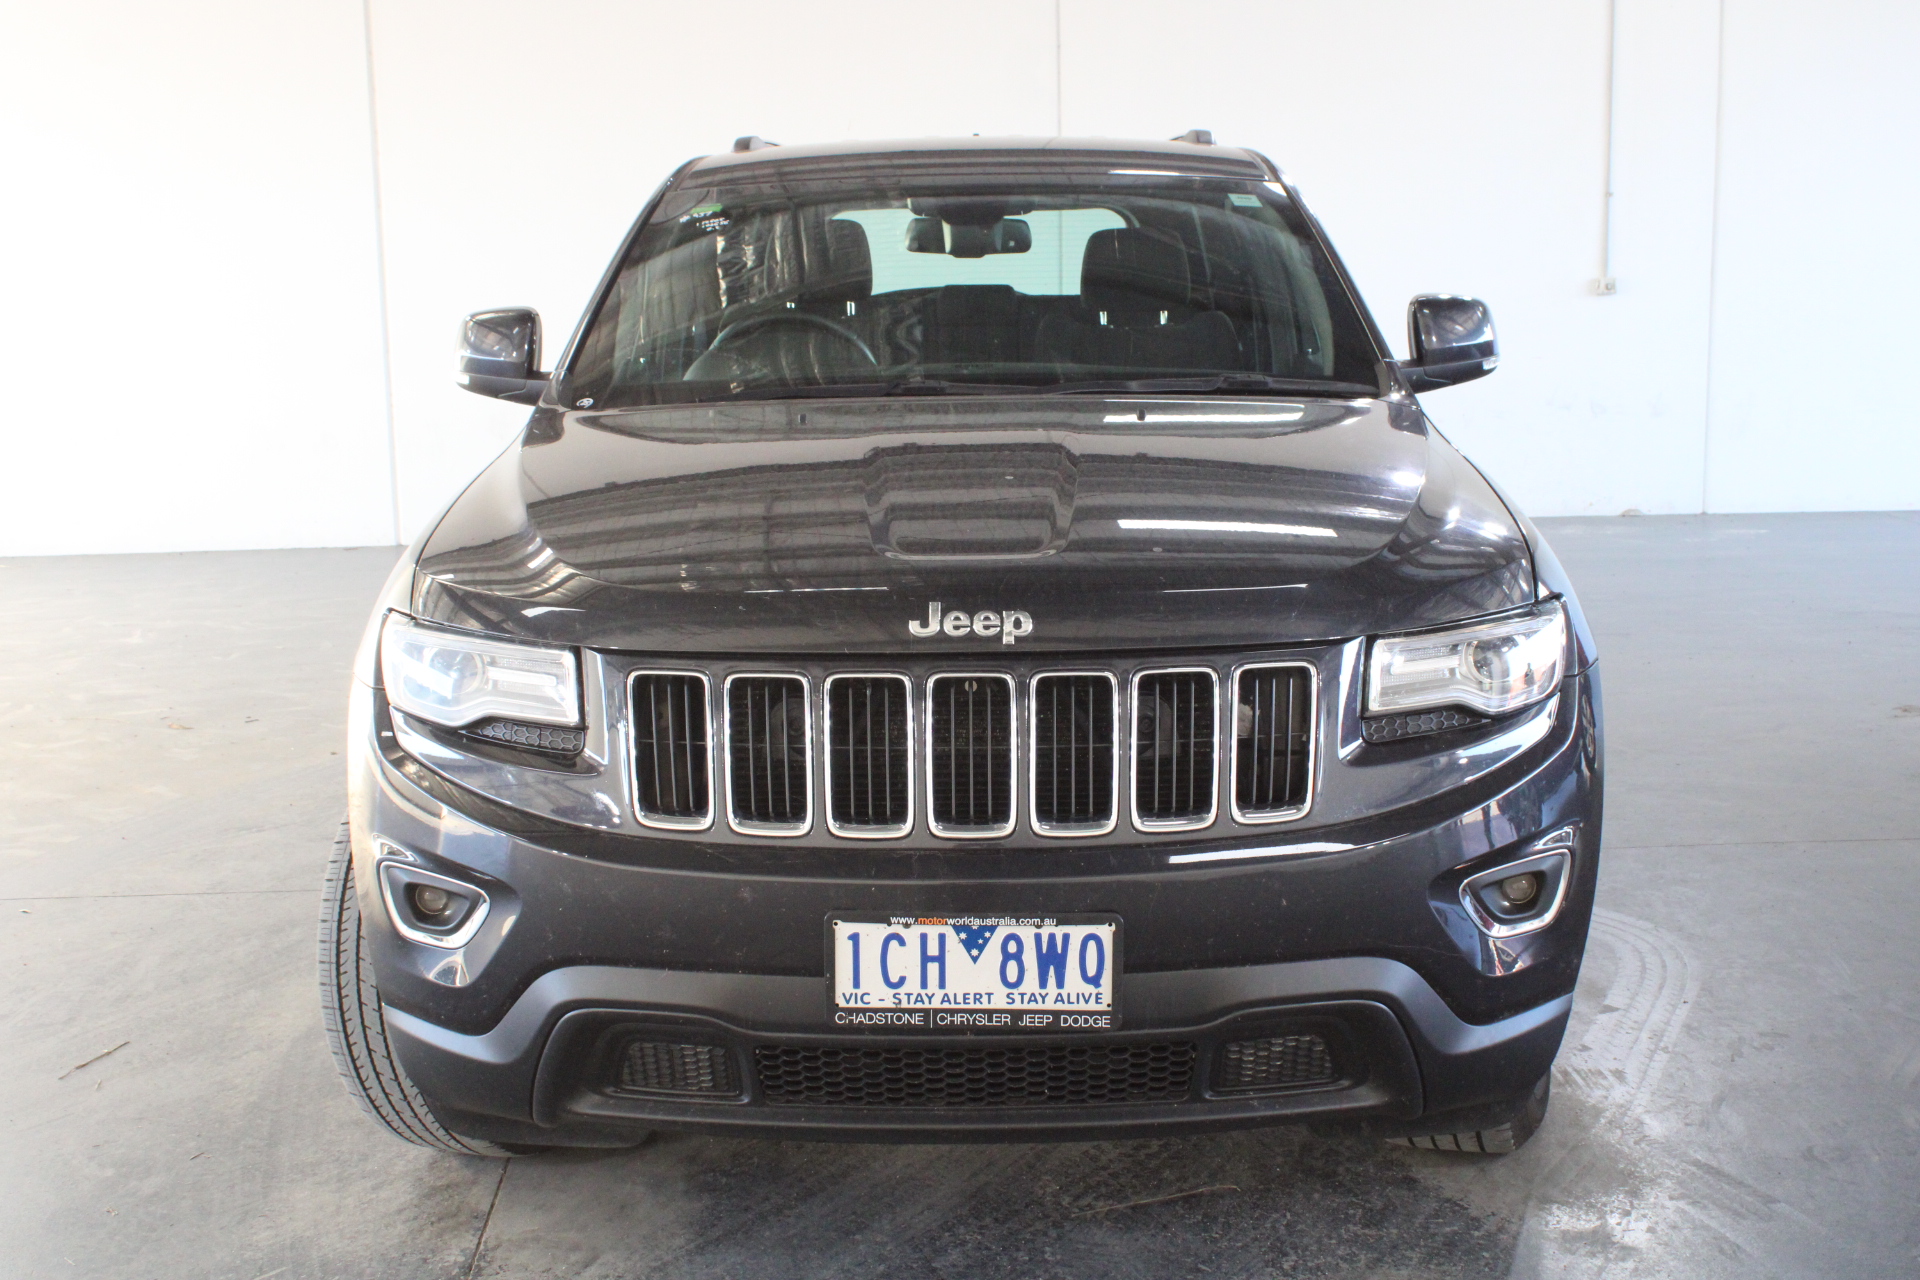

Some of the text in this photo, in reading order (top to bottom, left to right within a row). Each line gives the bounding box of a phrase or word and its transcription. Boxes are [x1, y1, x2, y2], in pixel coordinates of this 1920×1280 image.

[909, 601, 1033, 645] Jeep
[890, 916, 1057, 926] www.motorworldaustralia.com.au
[847, 931, 1106, 990] 1CH 8WQ
[842, 992, 871, 1005] VIC
[892, 992, 935, 1005] STAY
[940, 992, 994, 1006] ALERT
[1005, 992, 1049, 1005] STAY
[1053, 992, 1103, 1005] ALIVE
[835, 1012, 1111, 1028] CHADSTONE CHRYSLER JEEP DODGE
